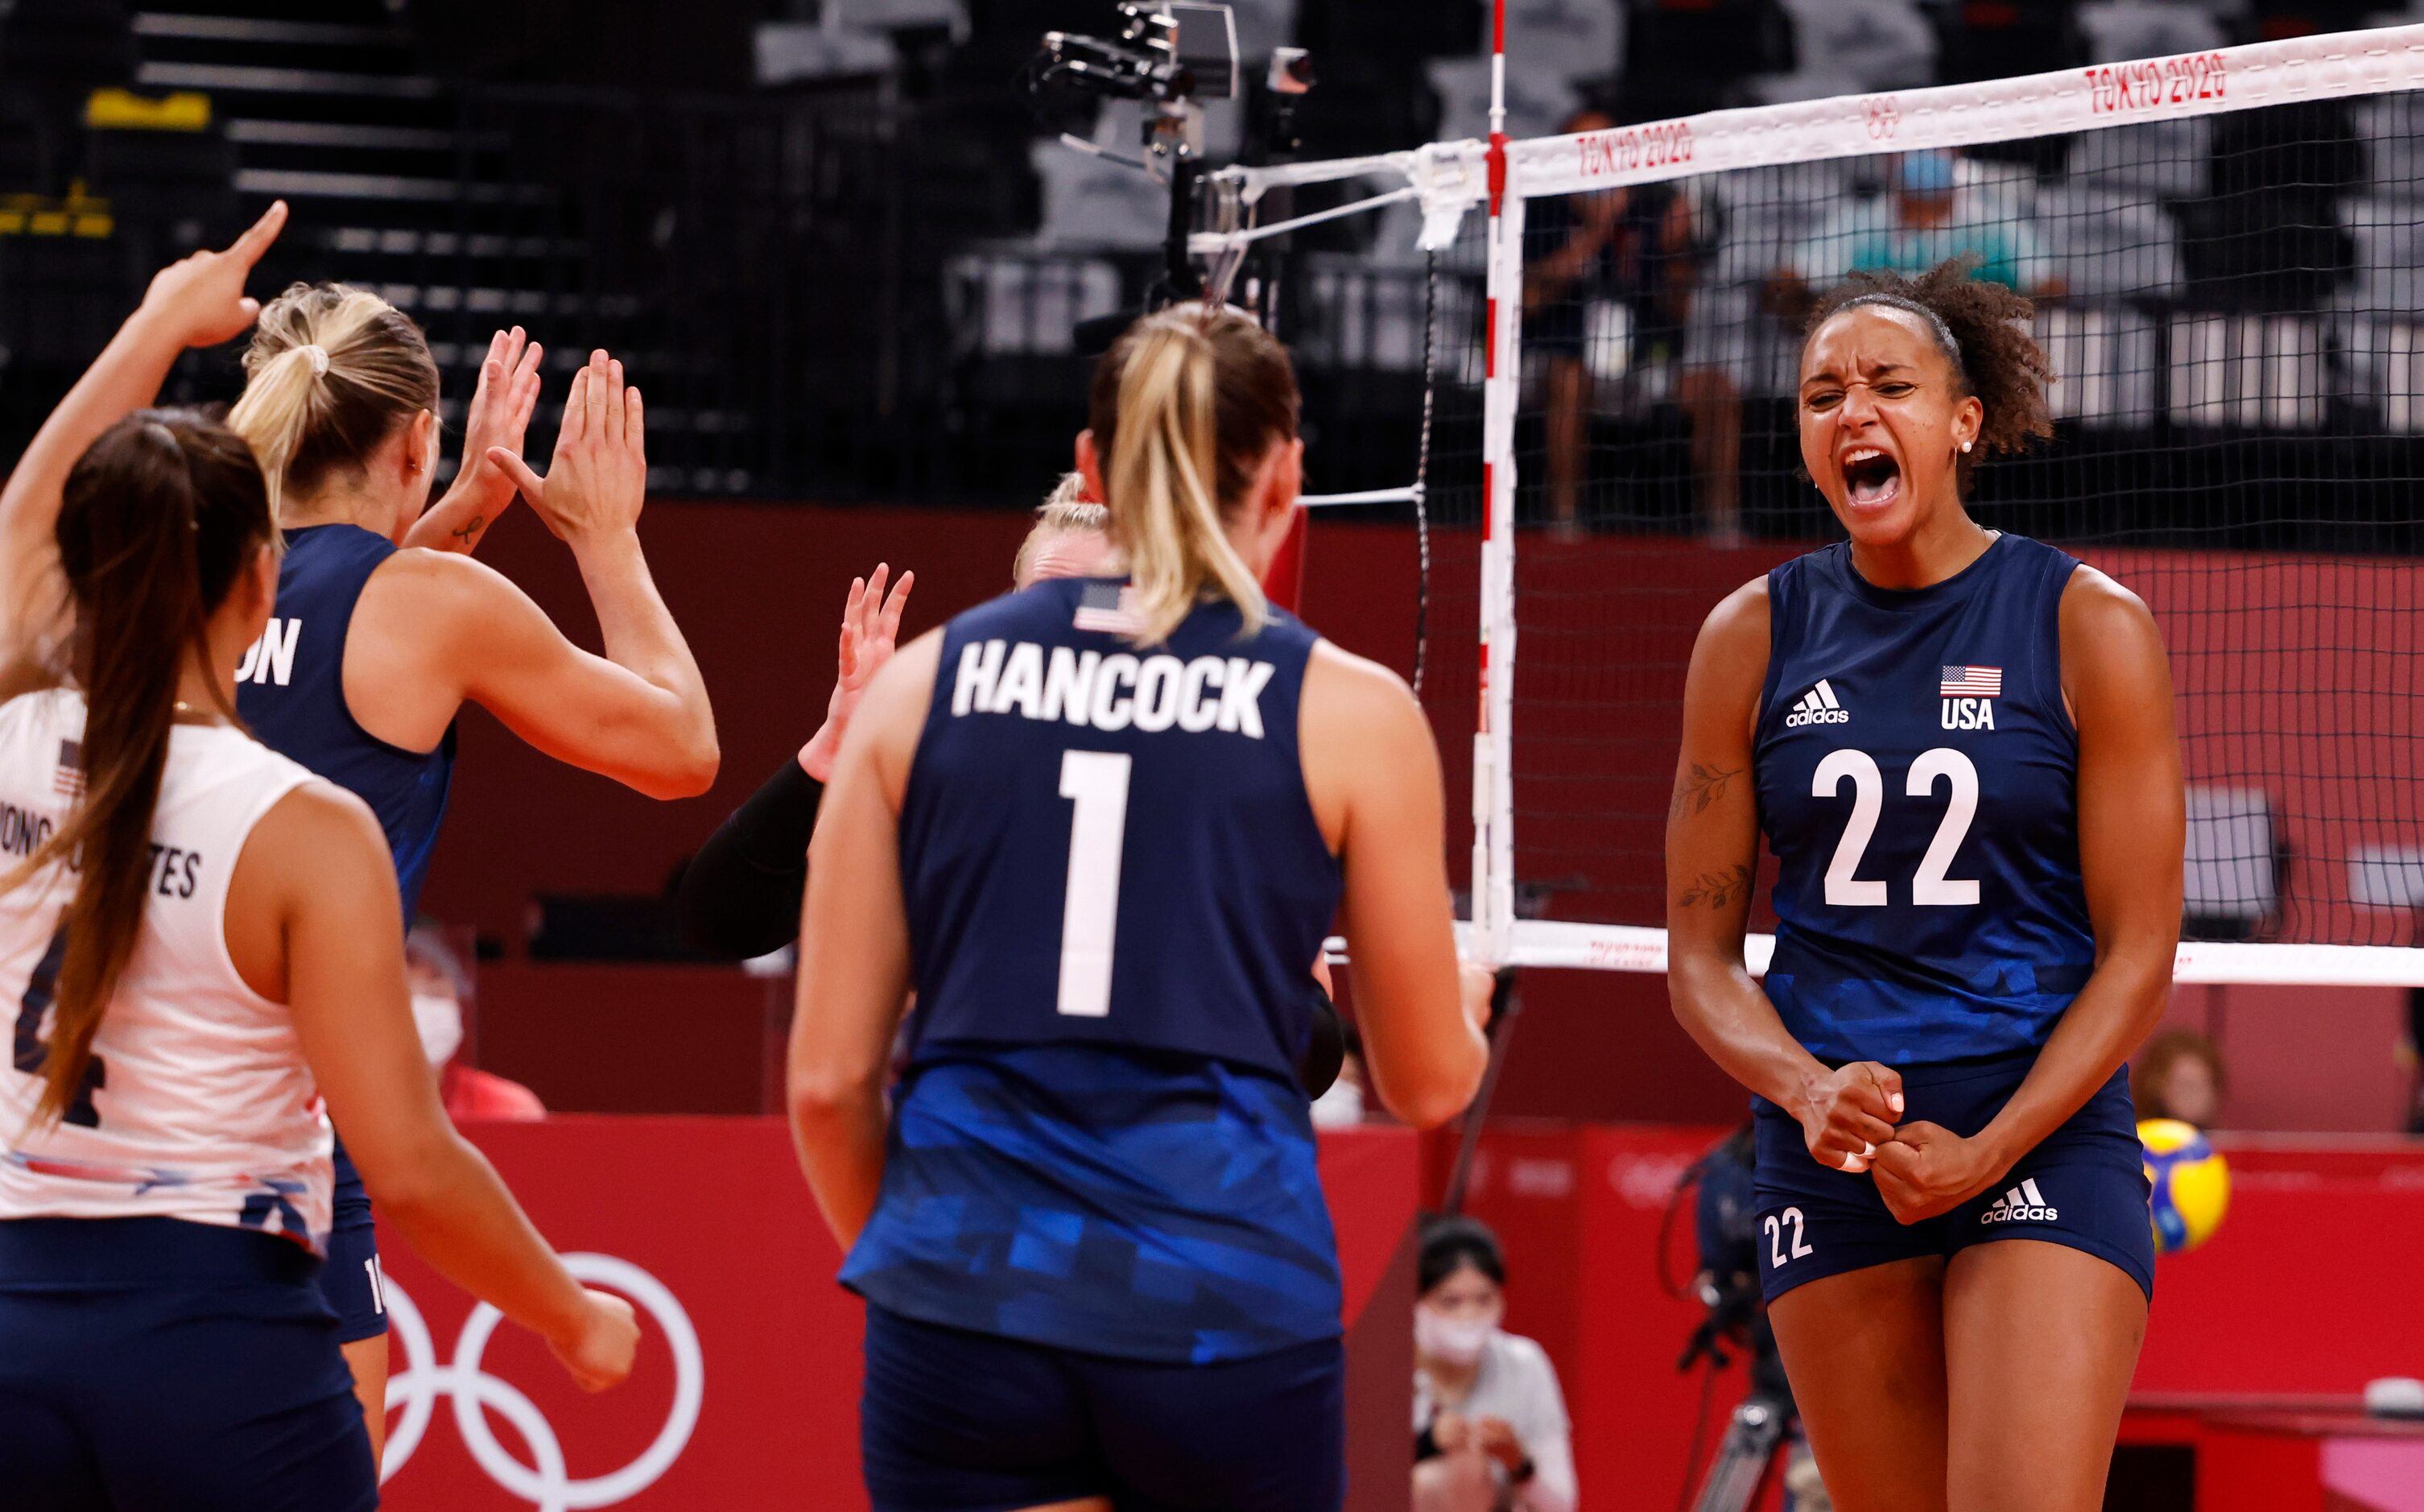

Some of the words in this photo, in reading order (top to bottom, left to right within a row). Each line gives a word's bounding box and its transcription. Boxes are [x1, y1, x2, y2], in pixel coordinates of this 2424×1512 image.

[2084, 62, 2161, 113] TOKYO
[2166, 53, 2227, 102] 2020
[1576, 130, 1639, 176] TOKYO
[1641, 122, 1693, 167] 2020
[951, 639, 1276, 740] HANCOCK
[1786, 708, 1849, 727] adidas
[1941, 698, 1995, 730] USA
[1811, 747, 1980, 906] 22
[1056, 749, 1132, 1018] 1
[1764, 1207, 1813, 1269] 22
[1980, 1204, 2058, 1225] adidas
